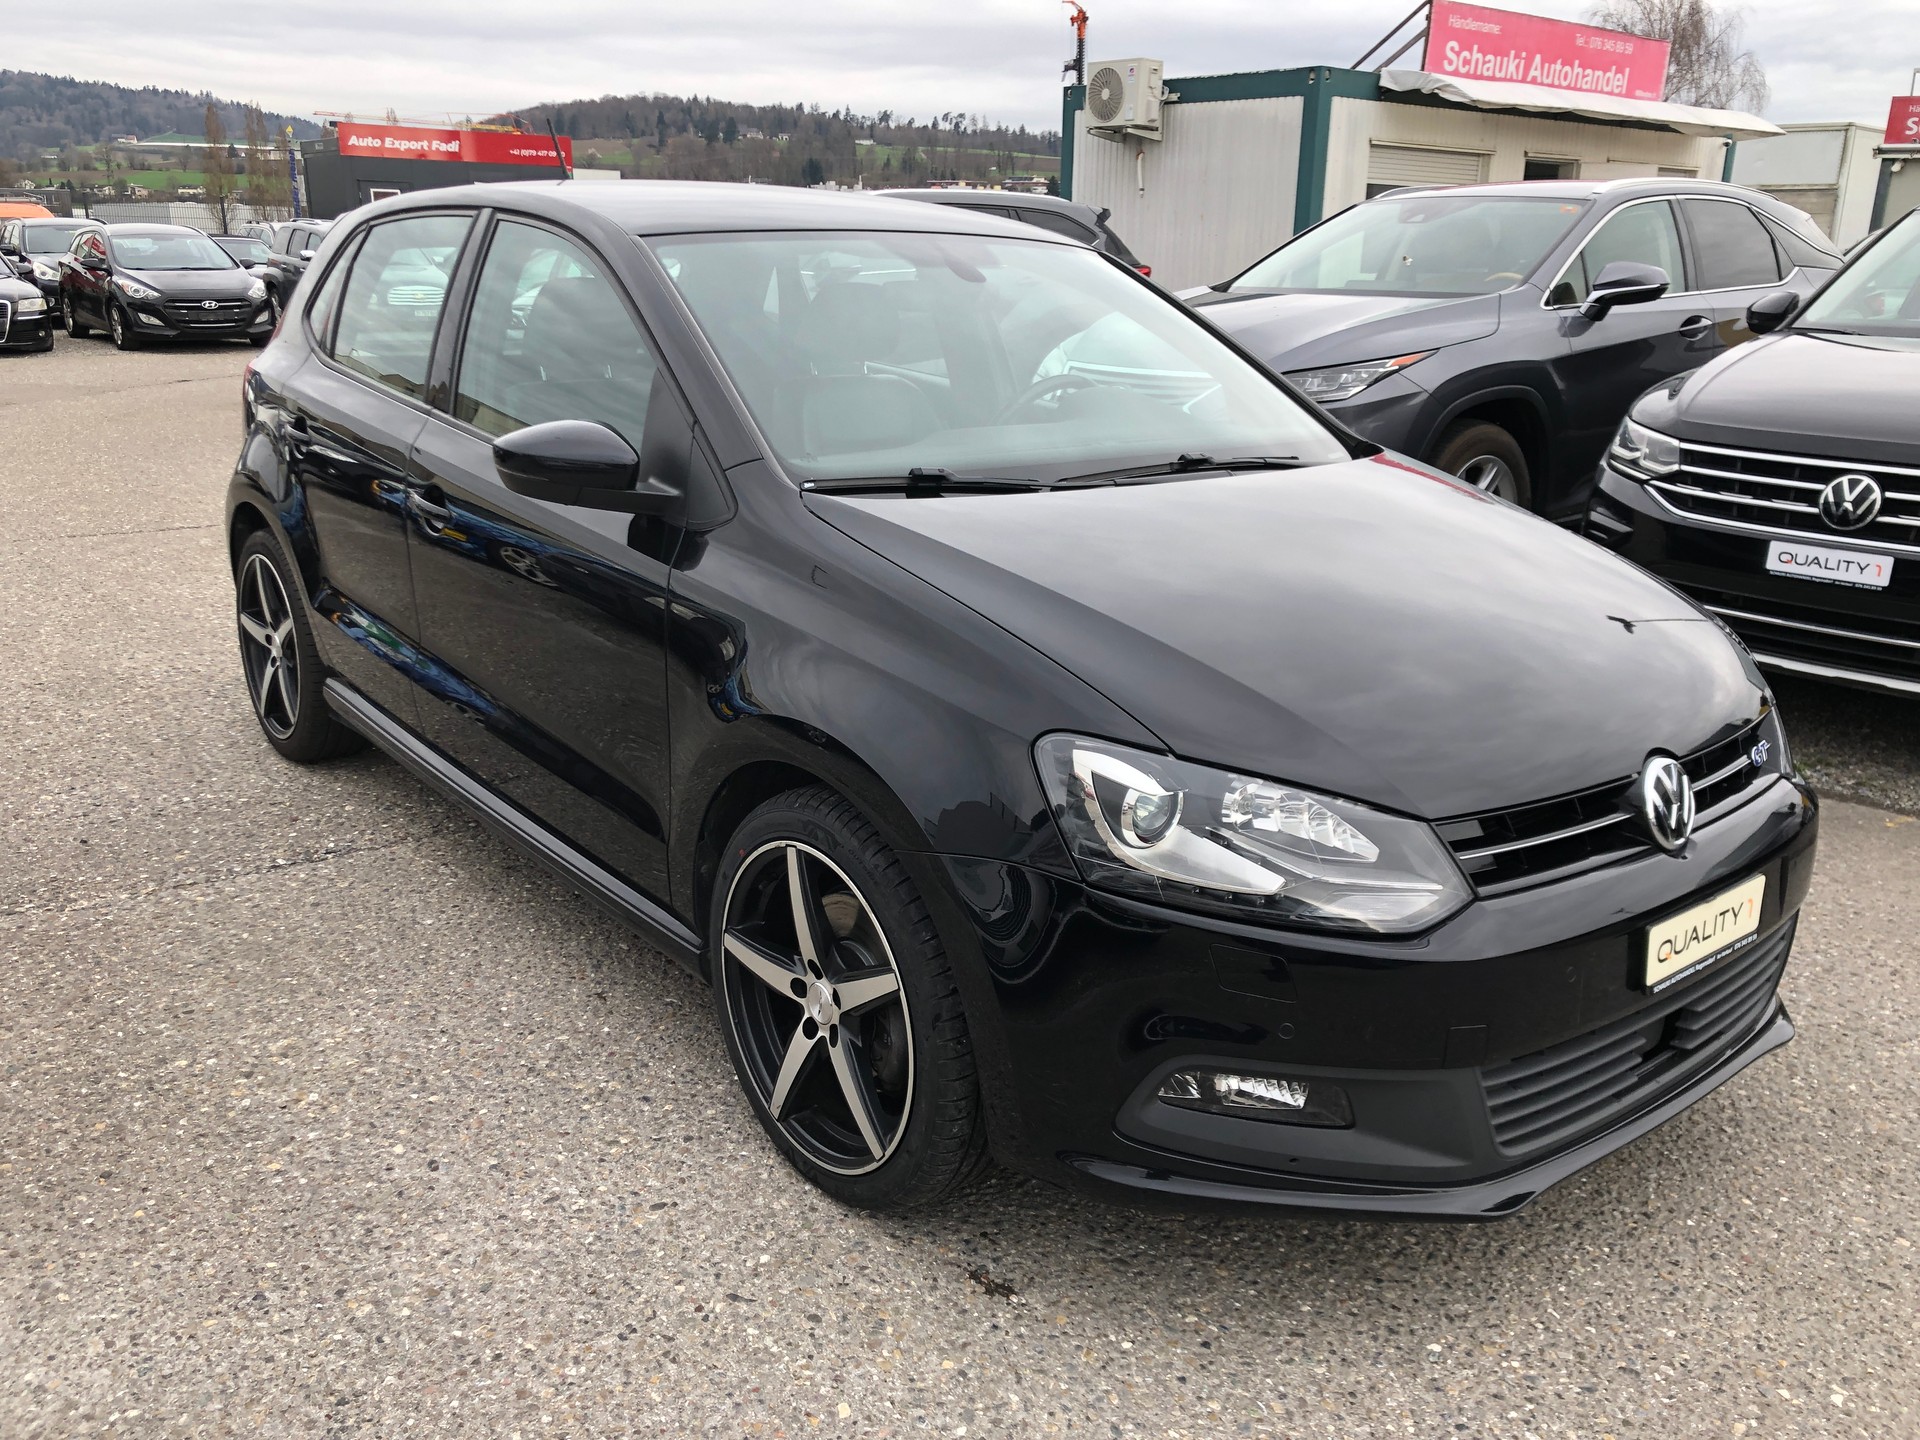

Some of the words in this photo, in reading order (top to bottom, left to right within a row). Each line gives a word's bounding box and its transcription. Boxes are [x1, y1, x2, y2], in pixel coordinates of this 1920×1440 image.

[1443, 40, 1526, 81] Schauki
[1527, 54, 1630, 95] Autohandel
[348, 135, 382, 148] Auto
[384, 137, 428, 151] Export
[431, 139, 460, 153] Fadi
[1777, 551, 1871, 575] QUALITY
[1657, 902, 1744, 963] QUALITY
